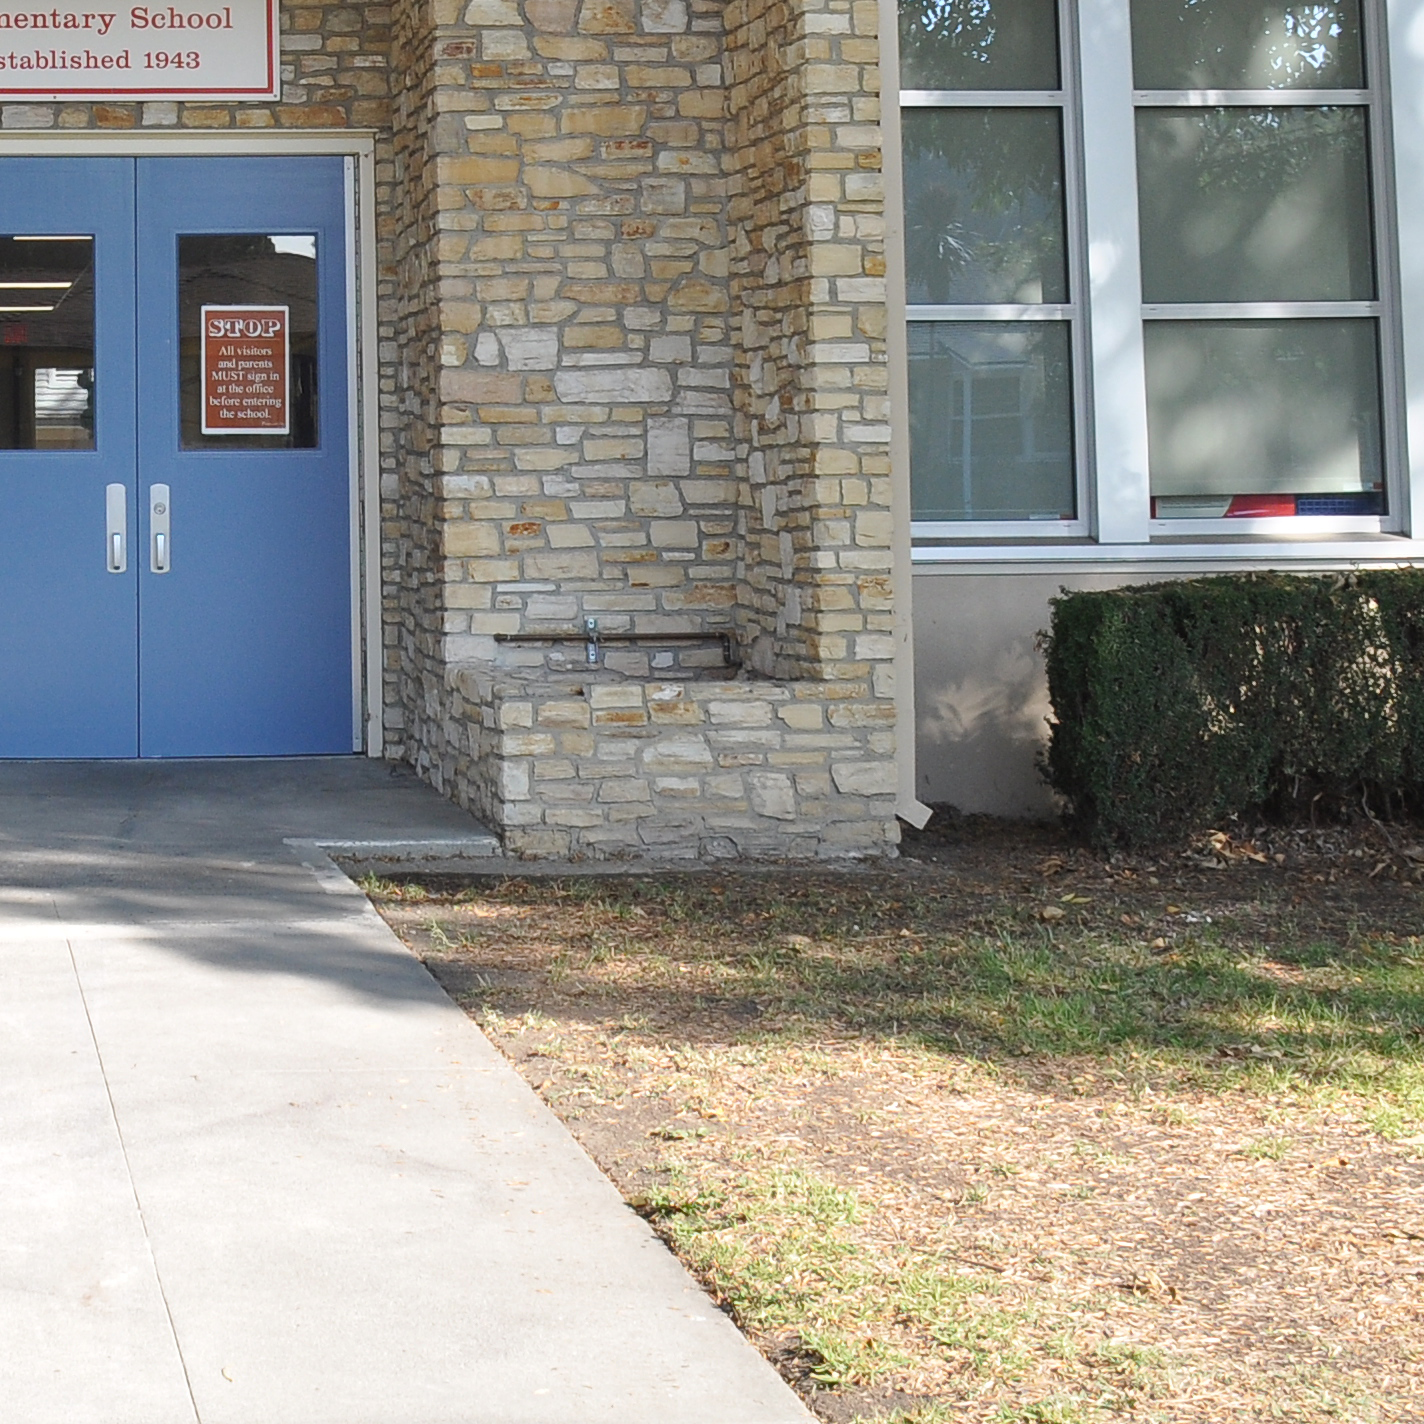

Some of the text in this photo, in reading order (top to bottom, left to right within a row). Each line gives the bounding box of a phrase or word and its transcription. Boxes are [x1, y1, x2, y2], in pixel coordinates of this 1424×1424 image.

[130, 7, 234, 30] School
[143, 51, 201, 70] 1943
[208, 319, 281, 337] STOP
[219, 346, 272, 356] All visitors
[218, 358, 273, 370] and parents
[211, 371, 280, 383] MUST sign in
[217, 384, 274, 393] at the office
[209, 396, 282, 408] before entering
[220, 409, 272, 418] the school.
